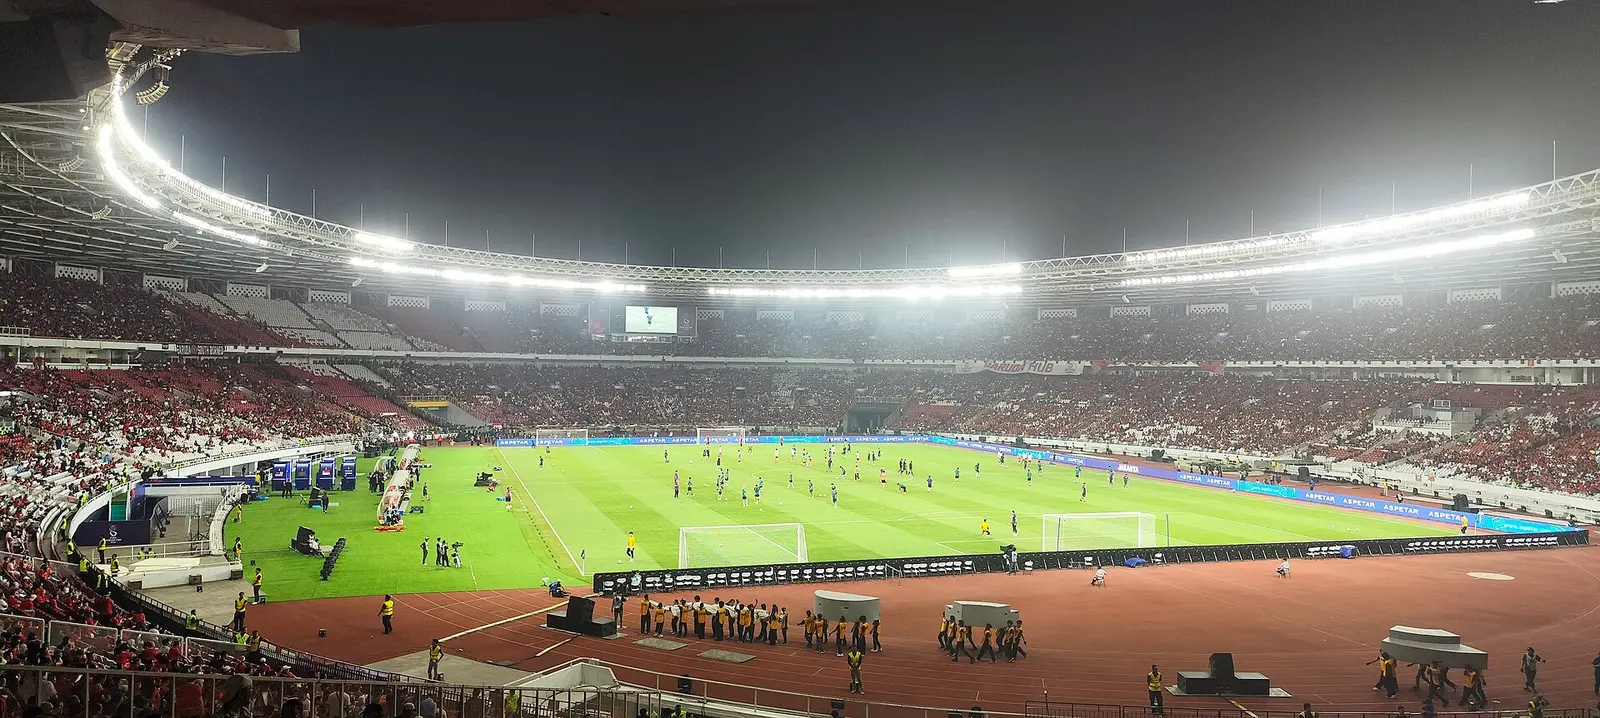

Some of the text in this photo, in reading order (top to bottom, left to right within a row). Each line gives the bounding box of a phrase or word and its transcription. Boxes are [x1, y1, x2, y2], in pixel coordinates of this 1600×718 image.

[1028, 361, 1054, 373] HUB
[1117, 463, 1140, 473] JAKARTA
[1180, 474, 1231, 487] ASPETAR ASPETAR
[1305, 492, 1464, 521] ASPETAR ASPETAR ASPETAR ASPETA
